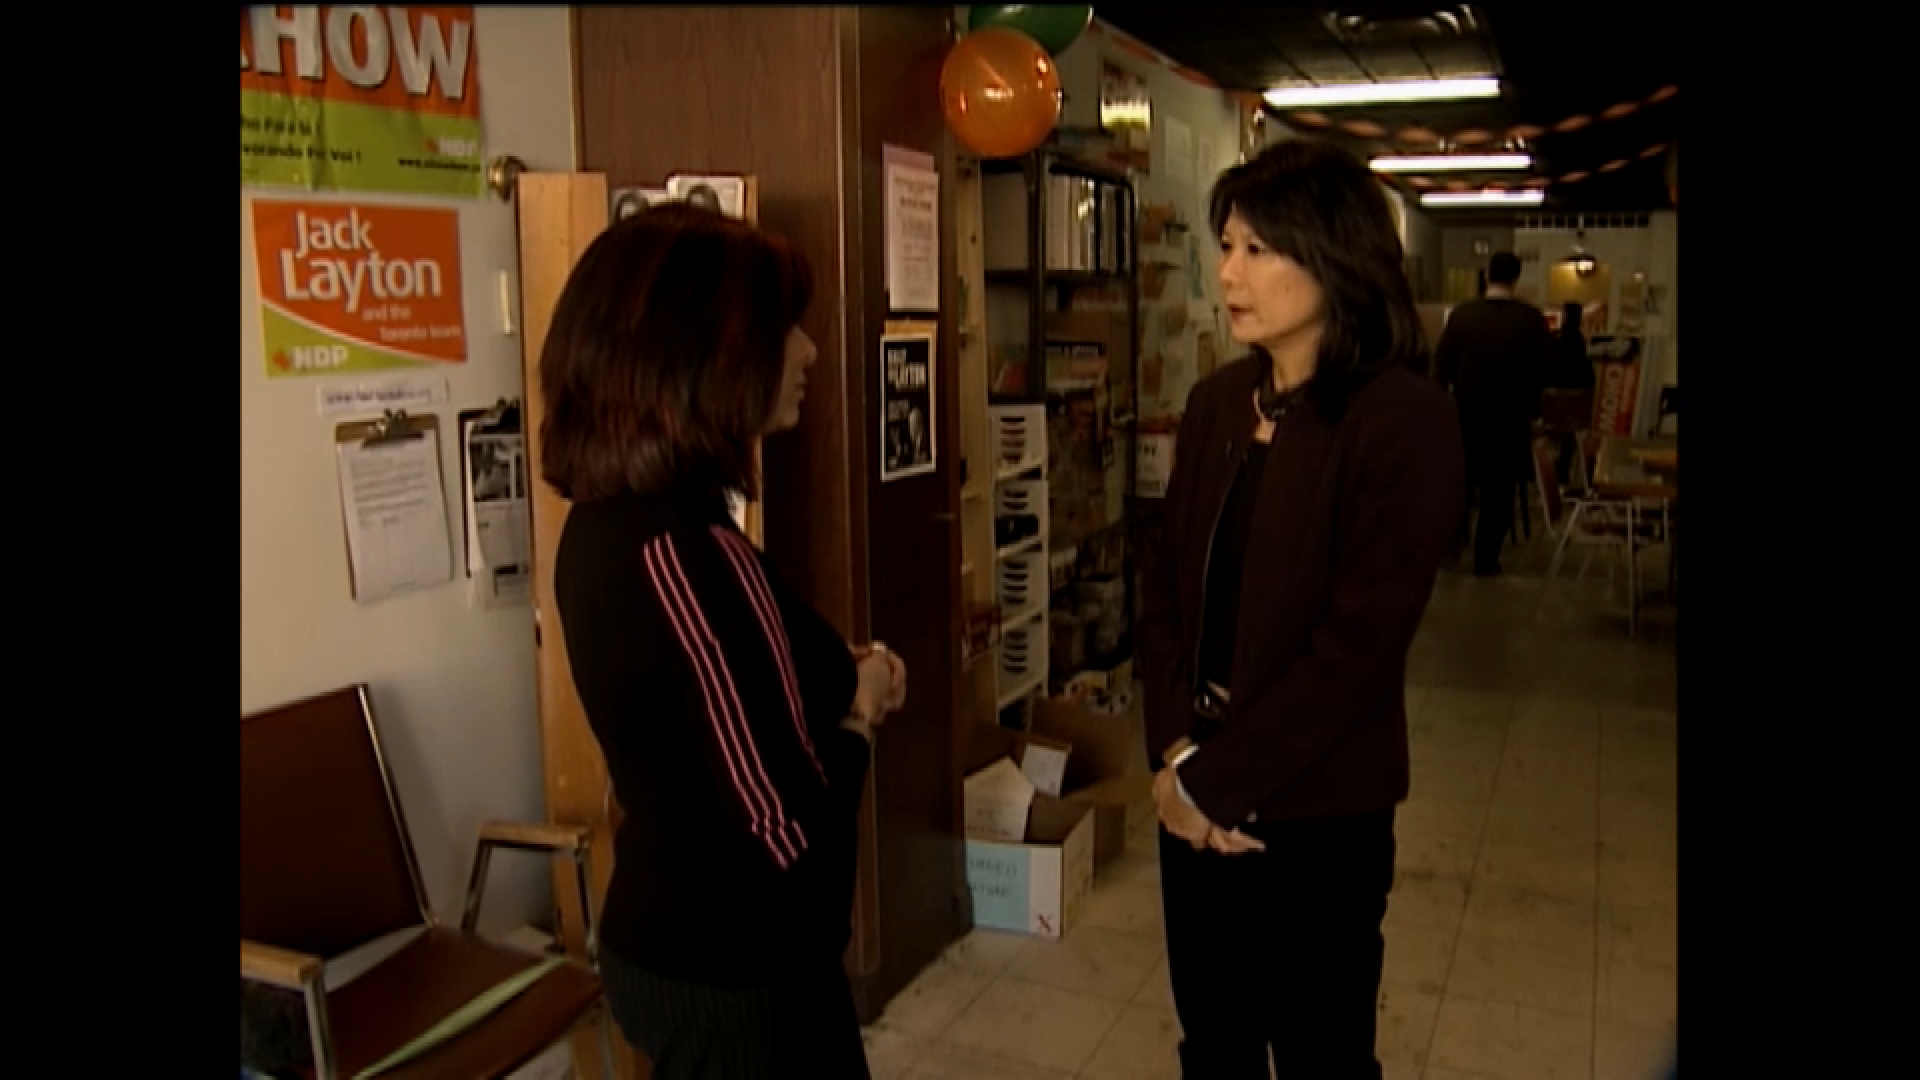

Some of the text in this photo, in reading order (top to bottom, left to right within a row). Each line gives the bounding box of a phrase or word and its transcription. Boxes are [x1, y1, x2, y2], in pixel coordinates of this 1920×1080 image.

[240, 6, 470, 100] HOW
[296, 208, 374, 259] Jack
[279, 248, 443, 313] Layton
[362, 303, 412, 322] and the
[292, 346, 349, 369] NDP
